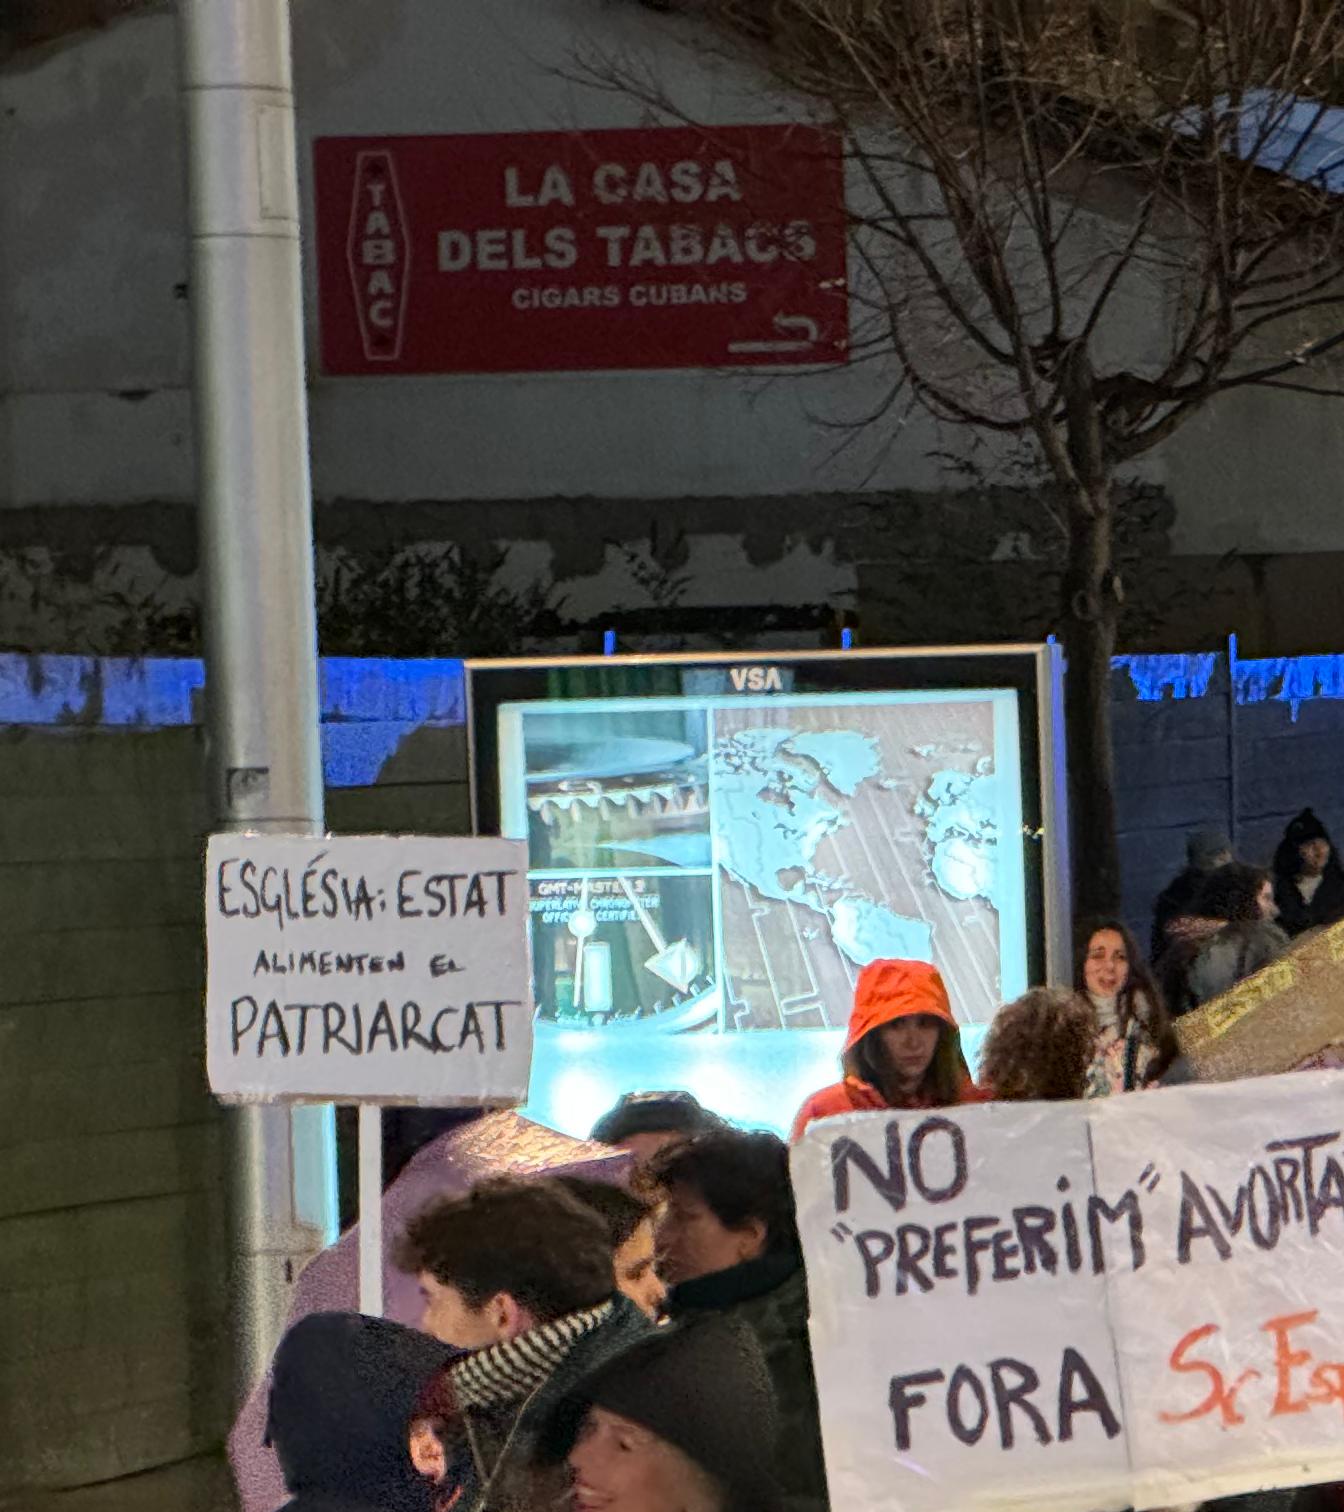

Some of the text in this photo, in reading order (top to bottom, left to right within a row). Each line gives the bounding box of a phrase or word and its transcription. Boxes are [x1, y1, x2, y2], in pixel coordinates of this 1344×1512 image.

[504, 161, 743, 209] LA CASA
[362, 182, 395, 327] TABAC
[437, 219, 818, 272] DELS TABACS
[511, 280, 748, 309] CIGARS CUBANS
[217, 851, 378, 931] ESGLÉSIA
[397, 870, 519, 918] ESTAT
[253, 949, 406, 978] ALIMENTEN
[230, 995, 523, 1058] PATRIARCAT
[831, 1116, 969, 1214] NO
[887, 1346, 1122, 1452] FORA
